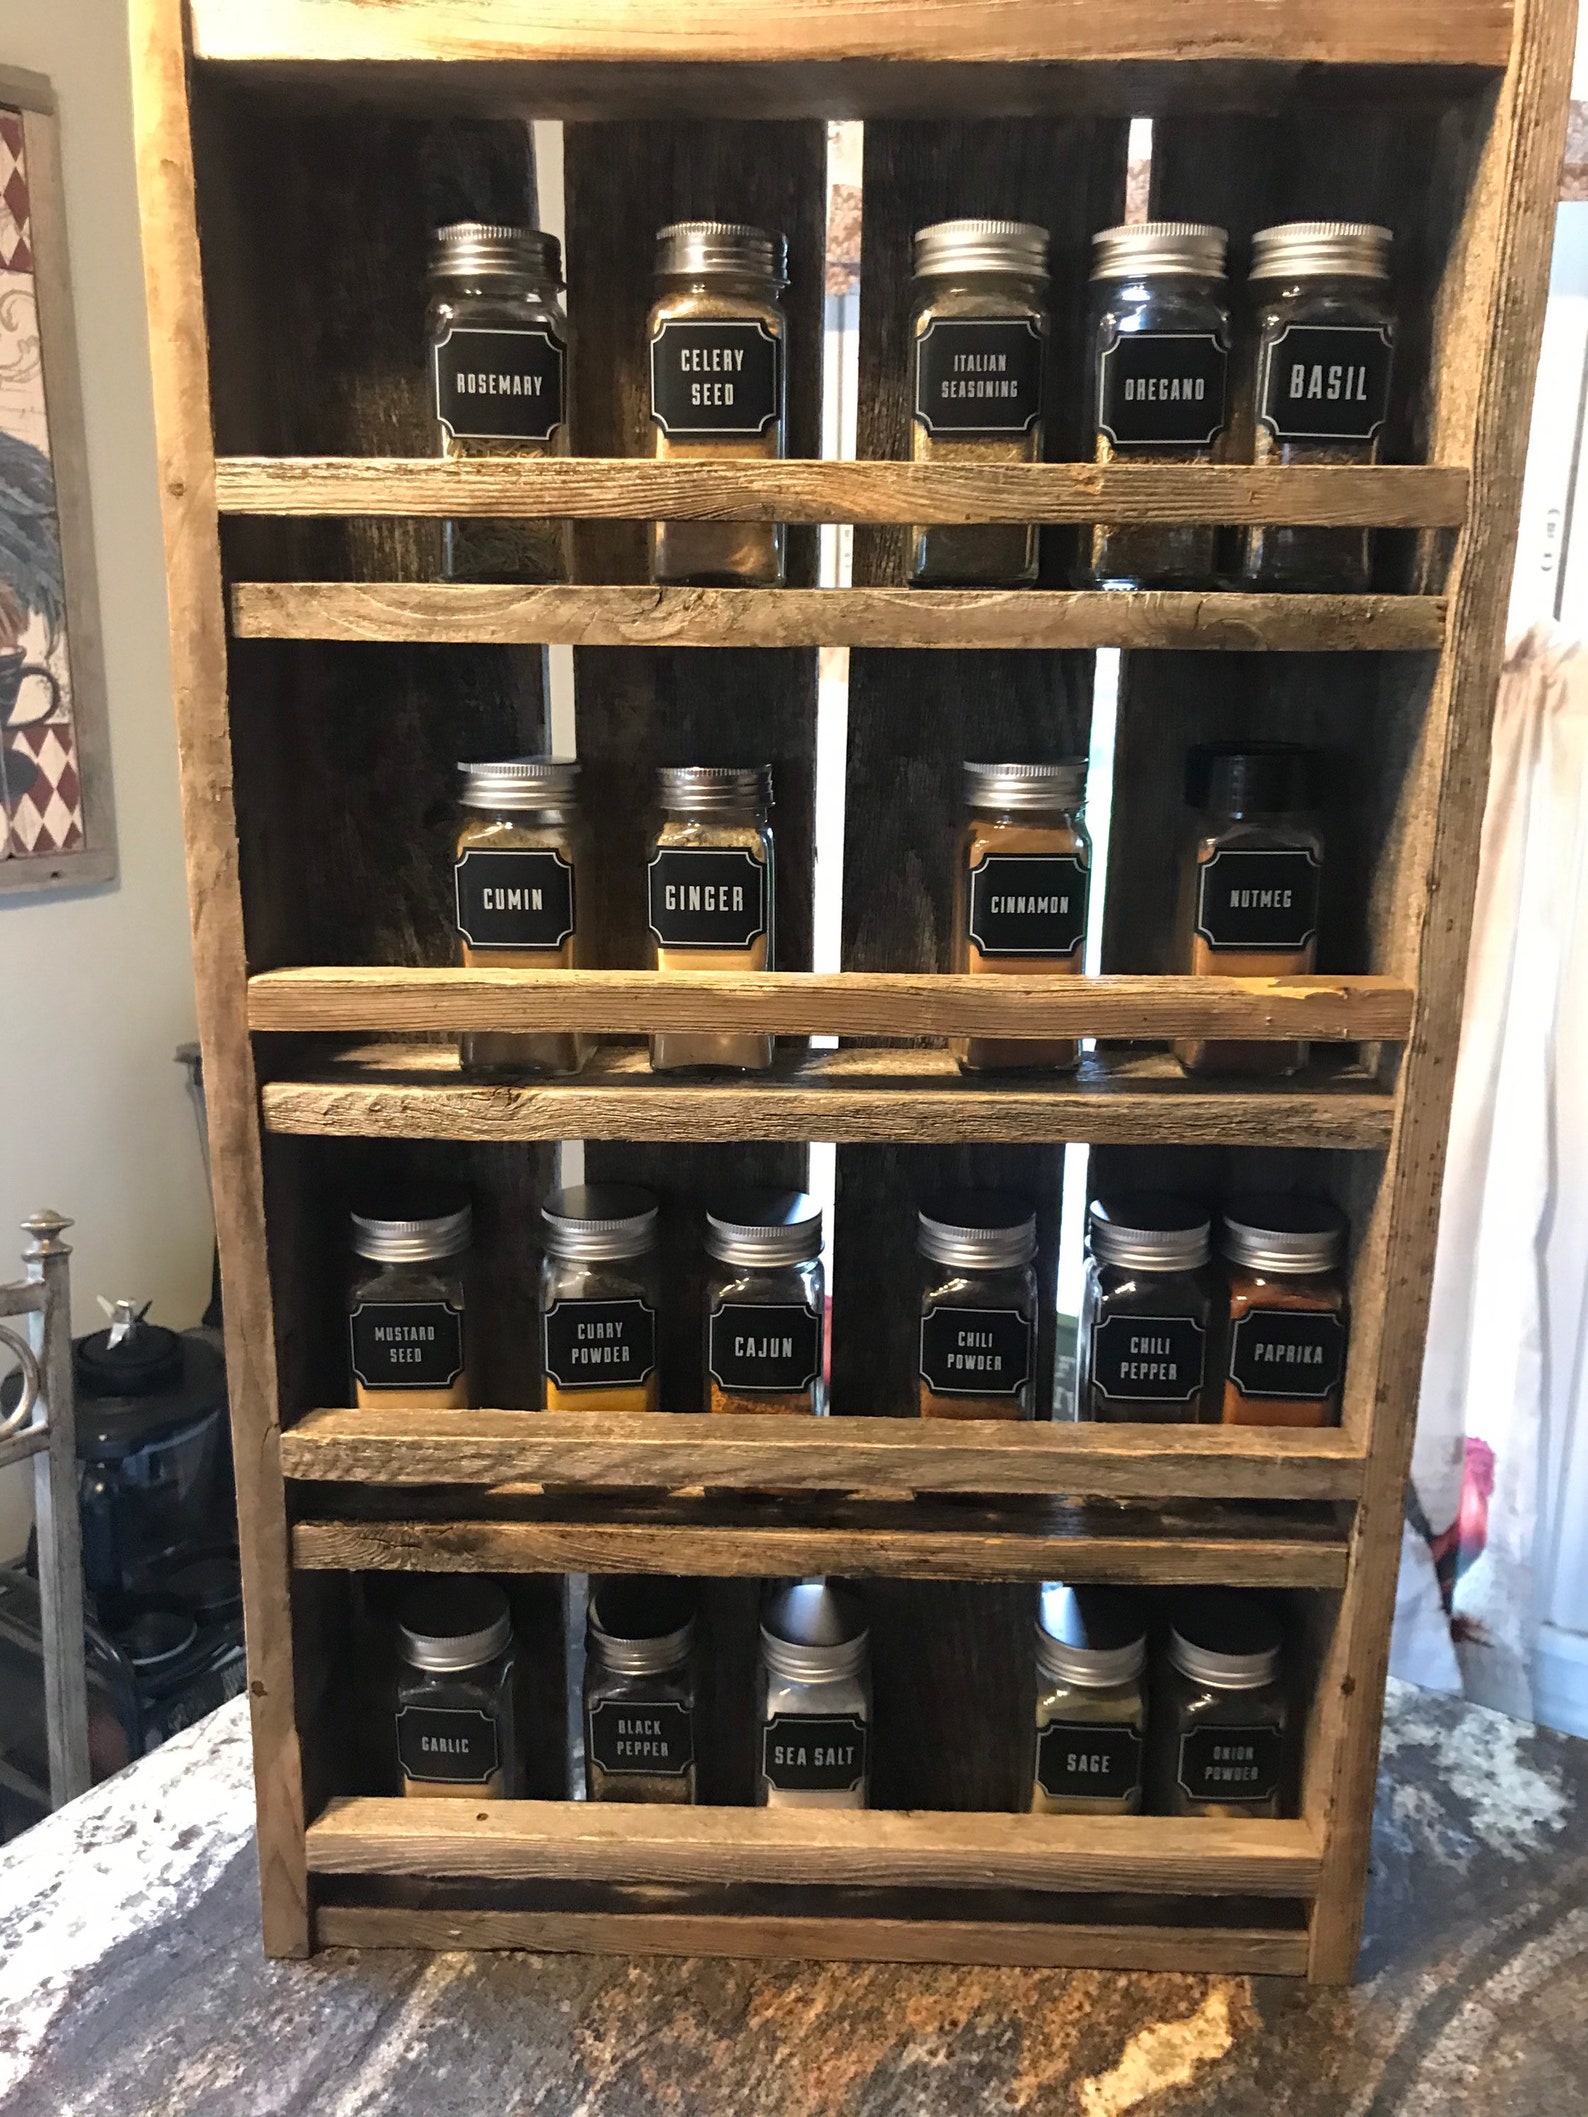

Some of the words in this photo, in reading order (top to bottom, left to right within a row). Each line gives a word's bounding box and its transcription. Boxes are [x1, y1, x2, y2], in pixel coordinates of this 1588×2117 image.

[680, 349, 744, 371] CELERY
[953, 354, 1007, 372] ITALIAN
[457, 373, 543, 396] ROSEMARY
[941, 380, 1018, 398] SEASONING
[1123, 378, 1204, 401] OREGANO
[1289, 364, 1367, 400] BASIL
[691, 383, 734, 405] SEED
[483, 888, 543, 910] CUMIN
[665, 885, 743, 911] GINGER
[990, 896, 1069, 914] CINNAMON
[1230, 890, 1292, 908] NUTMEG
[374, 1326, 435, 1341] MUSTARD
[577, 1322, 623, 1340] CURRY
[958, 1331, 993, 1348] CHILI
[571, 1346, 630, 1364] POWDER
[735, 1336, 792, 1358] CAJUN
[1129, 1337, 1170, 1355] CHILI
[1253, 1343, 1322, 1364] PAPRIKA
[389, 1348, 422, 1363] SEED
[947, 1353, 1002, 1371] POWDER
[1119, 1362, 1176, 1380] PEPPER
[618, 1720, 662, 1735] BLACK
[421, 1736, 469, 1753] GARLIC
[616, 1741, 668, 1757] PEPPER
[1213, 1745, 1254, 1761] ONION
[775, 1746, 807, 1766] SEA
[814, 1746, 854, 1766] SALT
[1065, 1753, 1110, 1773] SAGE
[1205, 1766, 1258, 1781] POWDER
